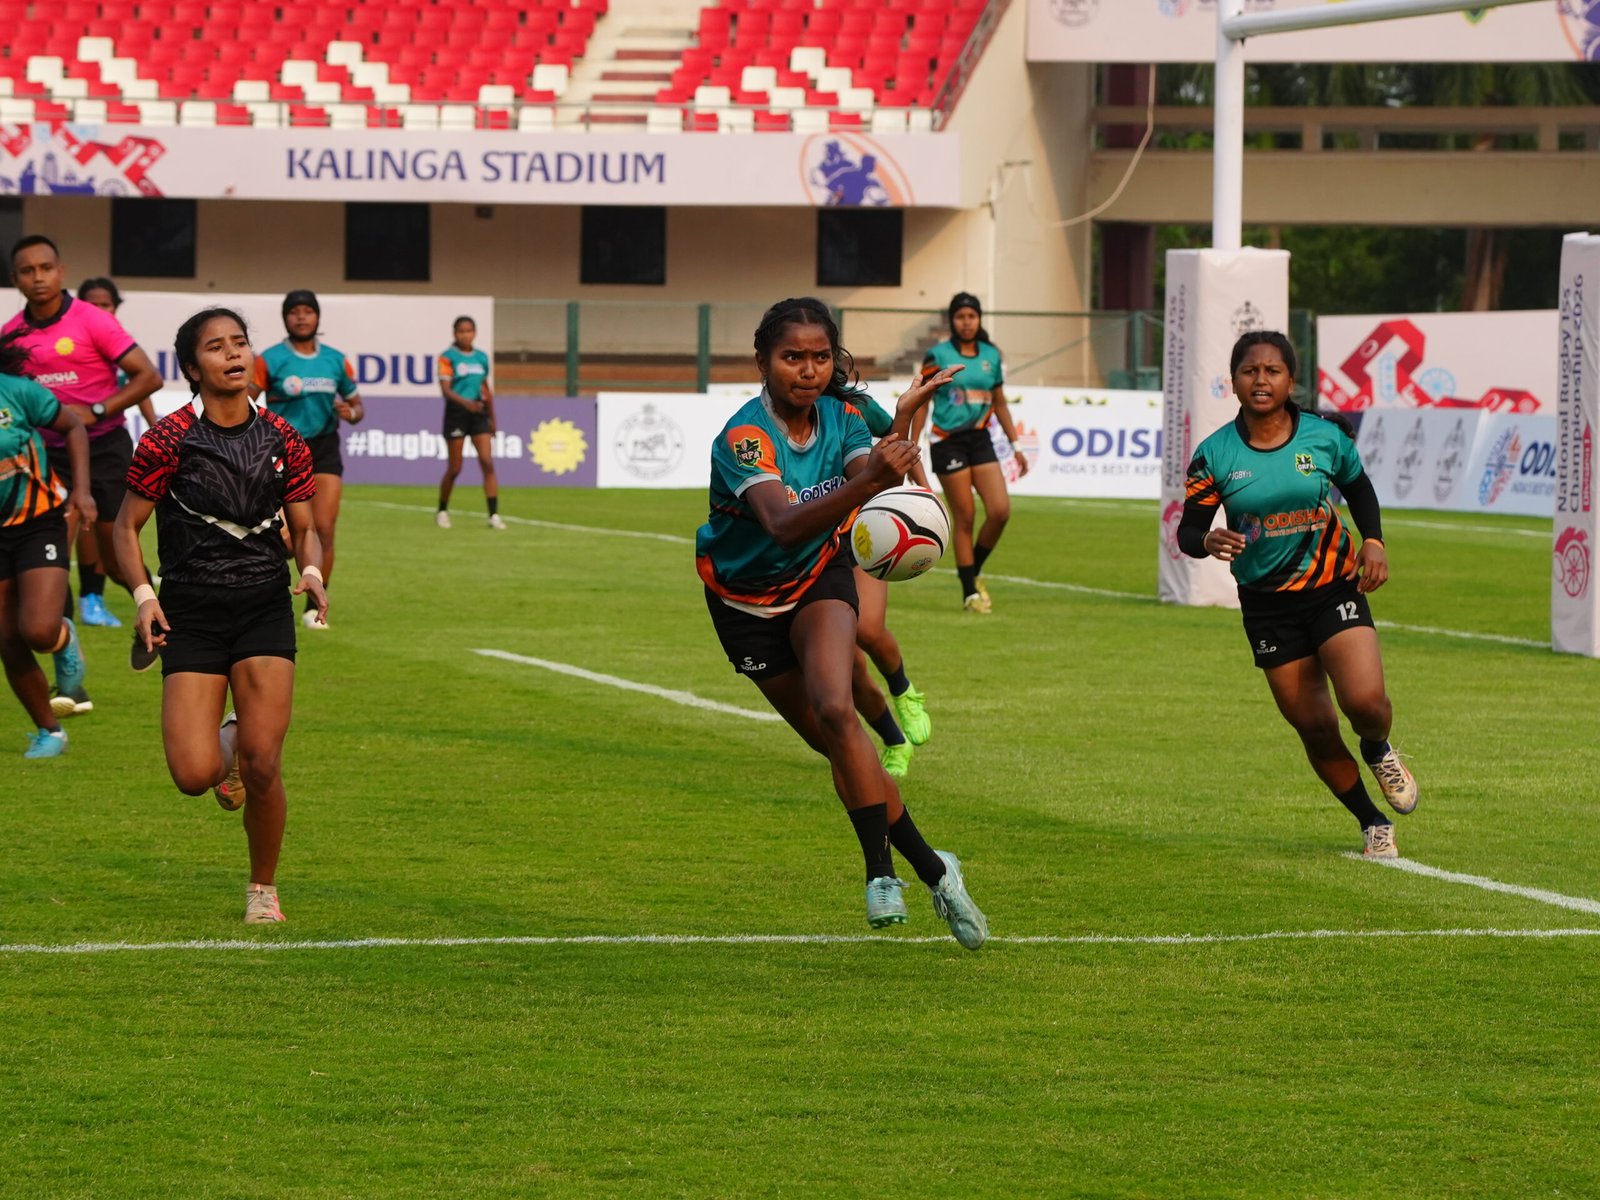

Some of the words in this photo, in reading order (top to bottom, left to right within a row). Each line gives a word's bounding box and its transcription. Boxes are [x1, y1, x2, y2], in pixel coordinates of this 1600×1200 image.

[286, 148, 467, 180] KALINGA
[481, 151, 667, 184] STADIUM
[1561, 287, 1571, 321] 15s
[1560, 329, 1572, 403] Rugby
[1571, 337, 1584, 513] Championship
[1557, 408, 1570, 513] National
[1264, 507, 1327, 529] ODISHA
[45, 544, 57, 560] 3
[1336, 601, 1359, 621] 12
